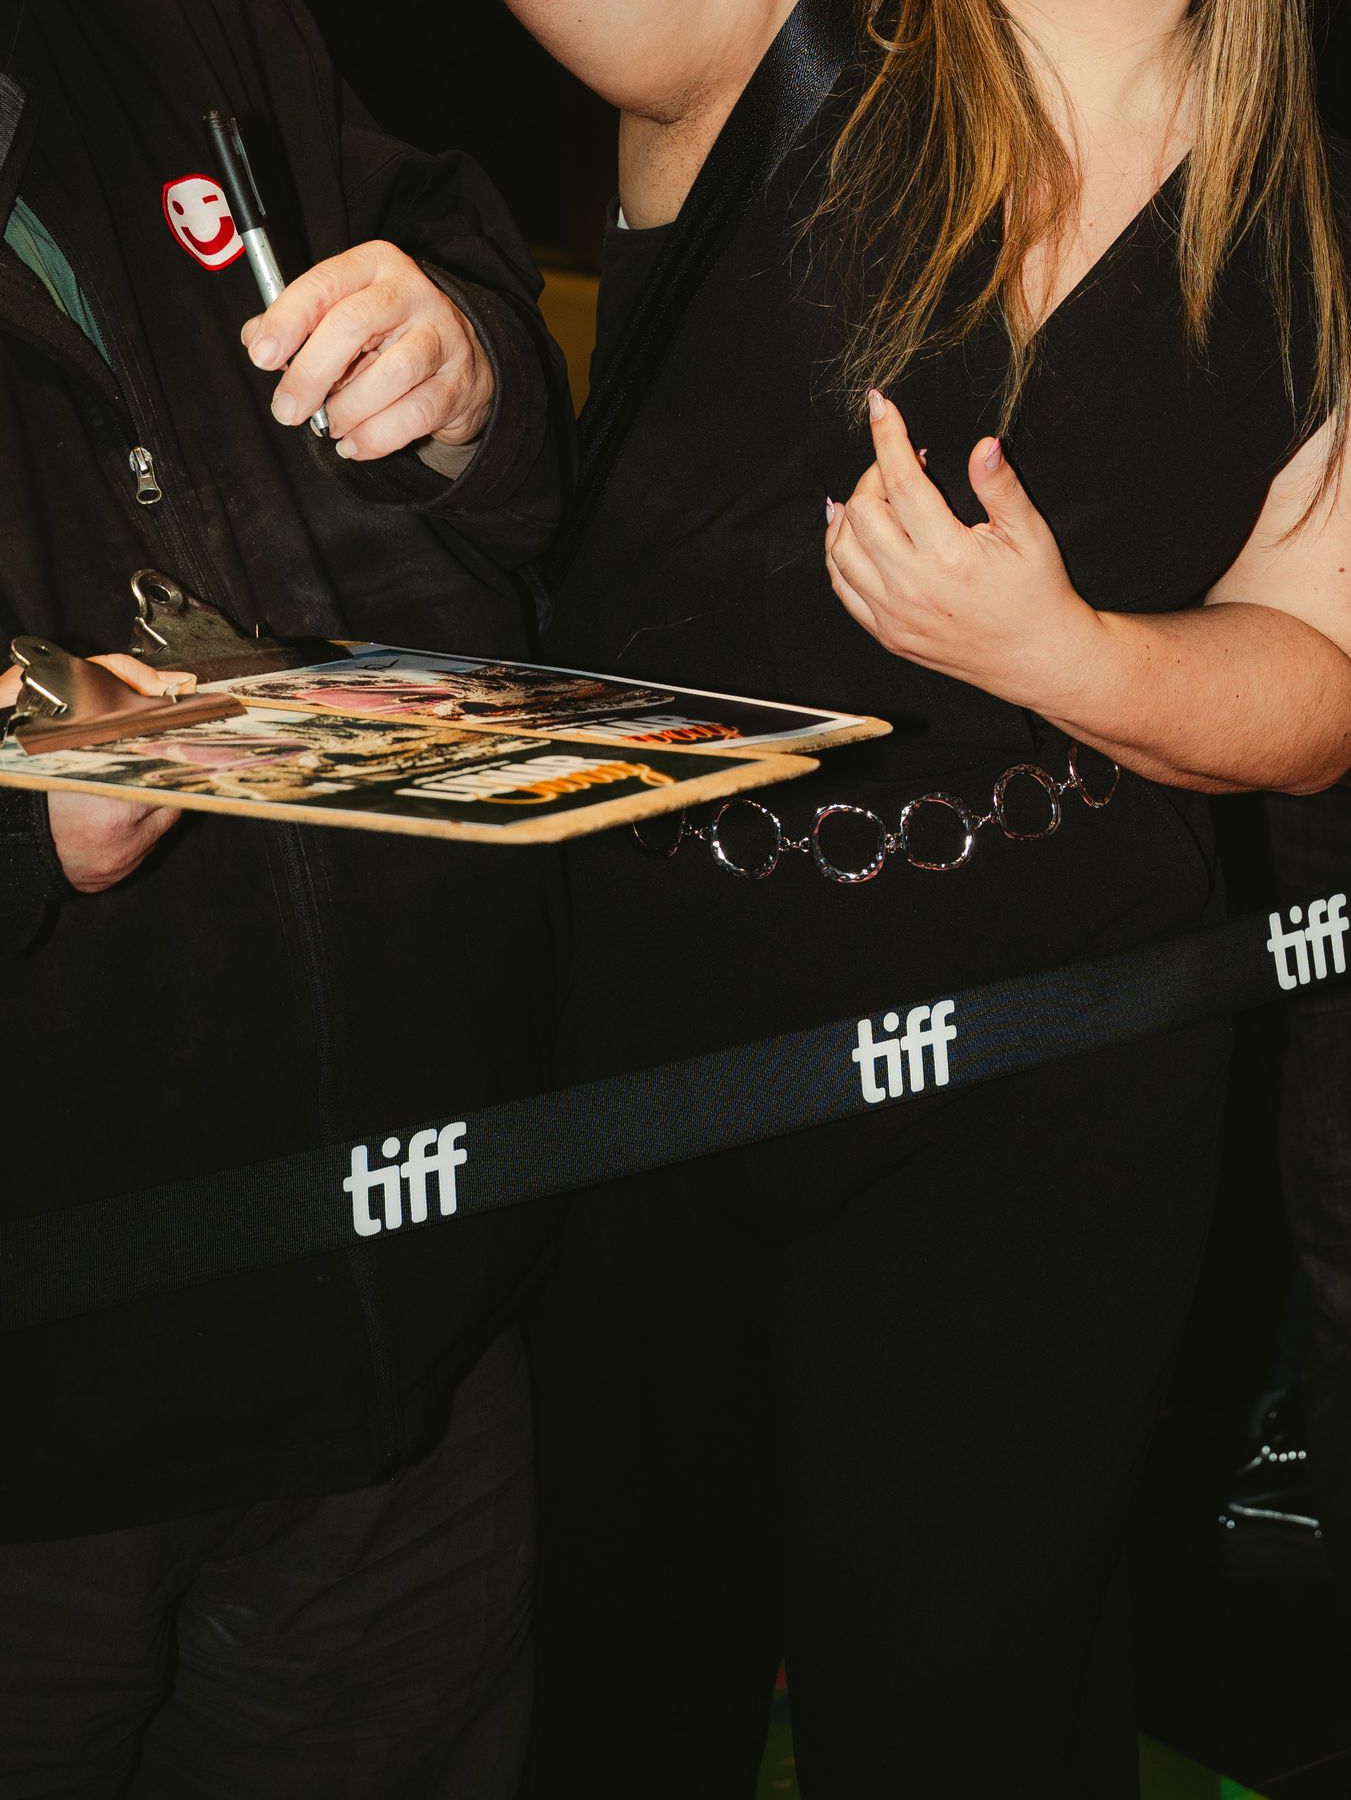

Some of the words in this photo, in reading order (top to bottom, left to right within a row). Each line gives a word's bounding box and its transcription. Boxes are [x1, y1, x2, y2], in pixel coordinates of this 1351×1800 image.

[1266, 893, 1350, 991] tiff
[851, 999, 958, 1104] tiff
[342, 1121, 468, 1237] tiff
